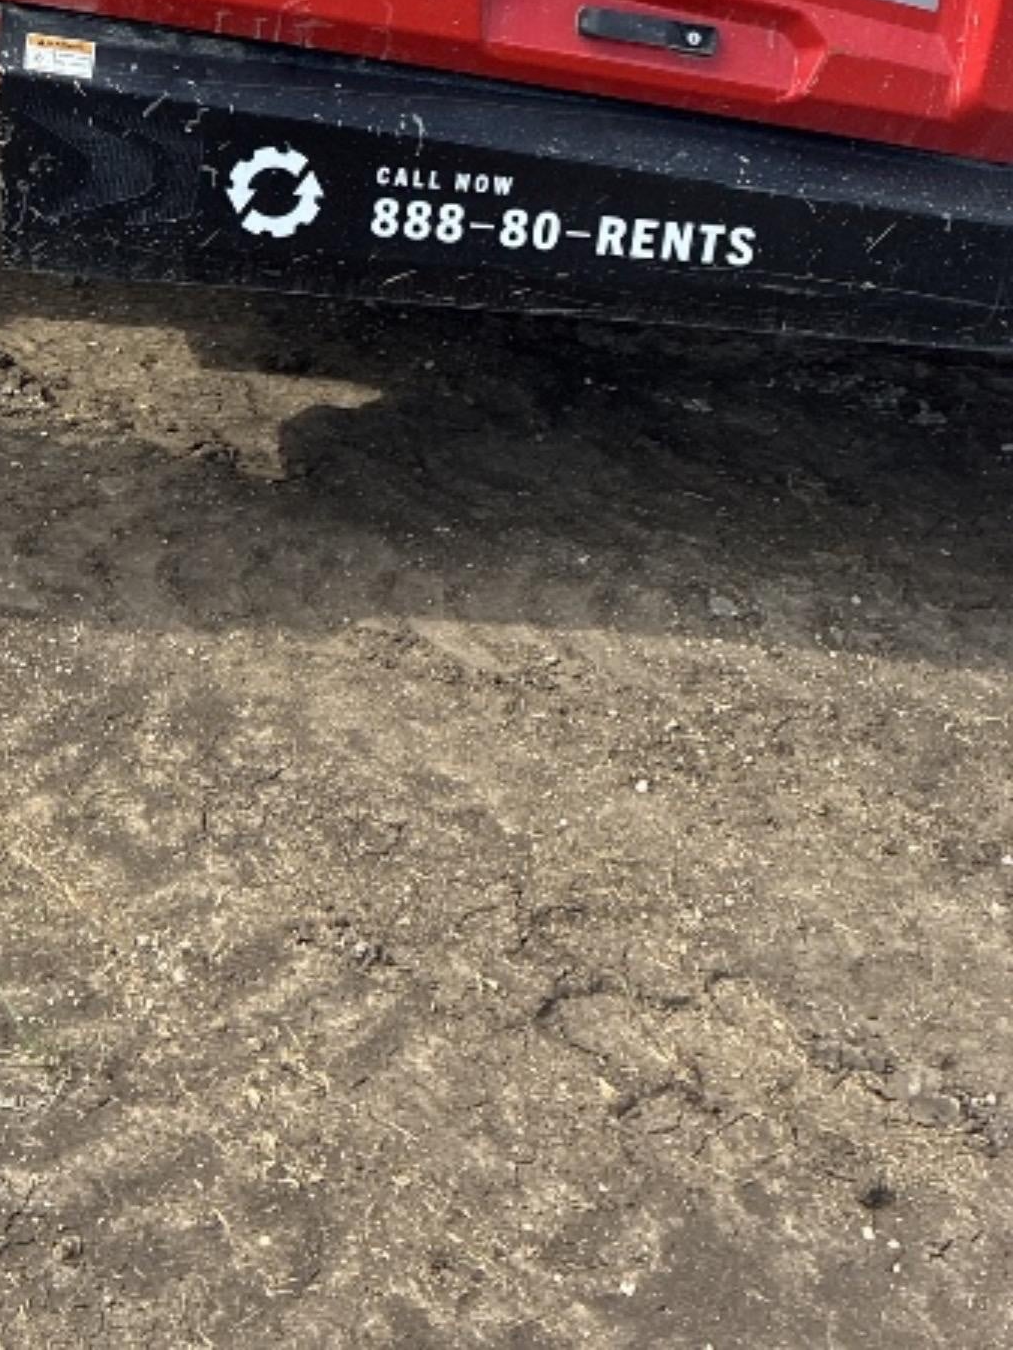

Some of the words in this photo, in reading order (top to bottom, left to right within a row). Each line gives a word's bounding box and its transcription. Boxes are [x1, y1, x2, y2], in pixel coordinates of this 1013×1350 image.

[376, 166, 441, 190] CALL
[454, 172, 514, 196] NOW
[370, 197, 757, 267] 888-80-RENTS
